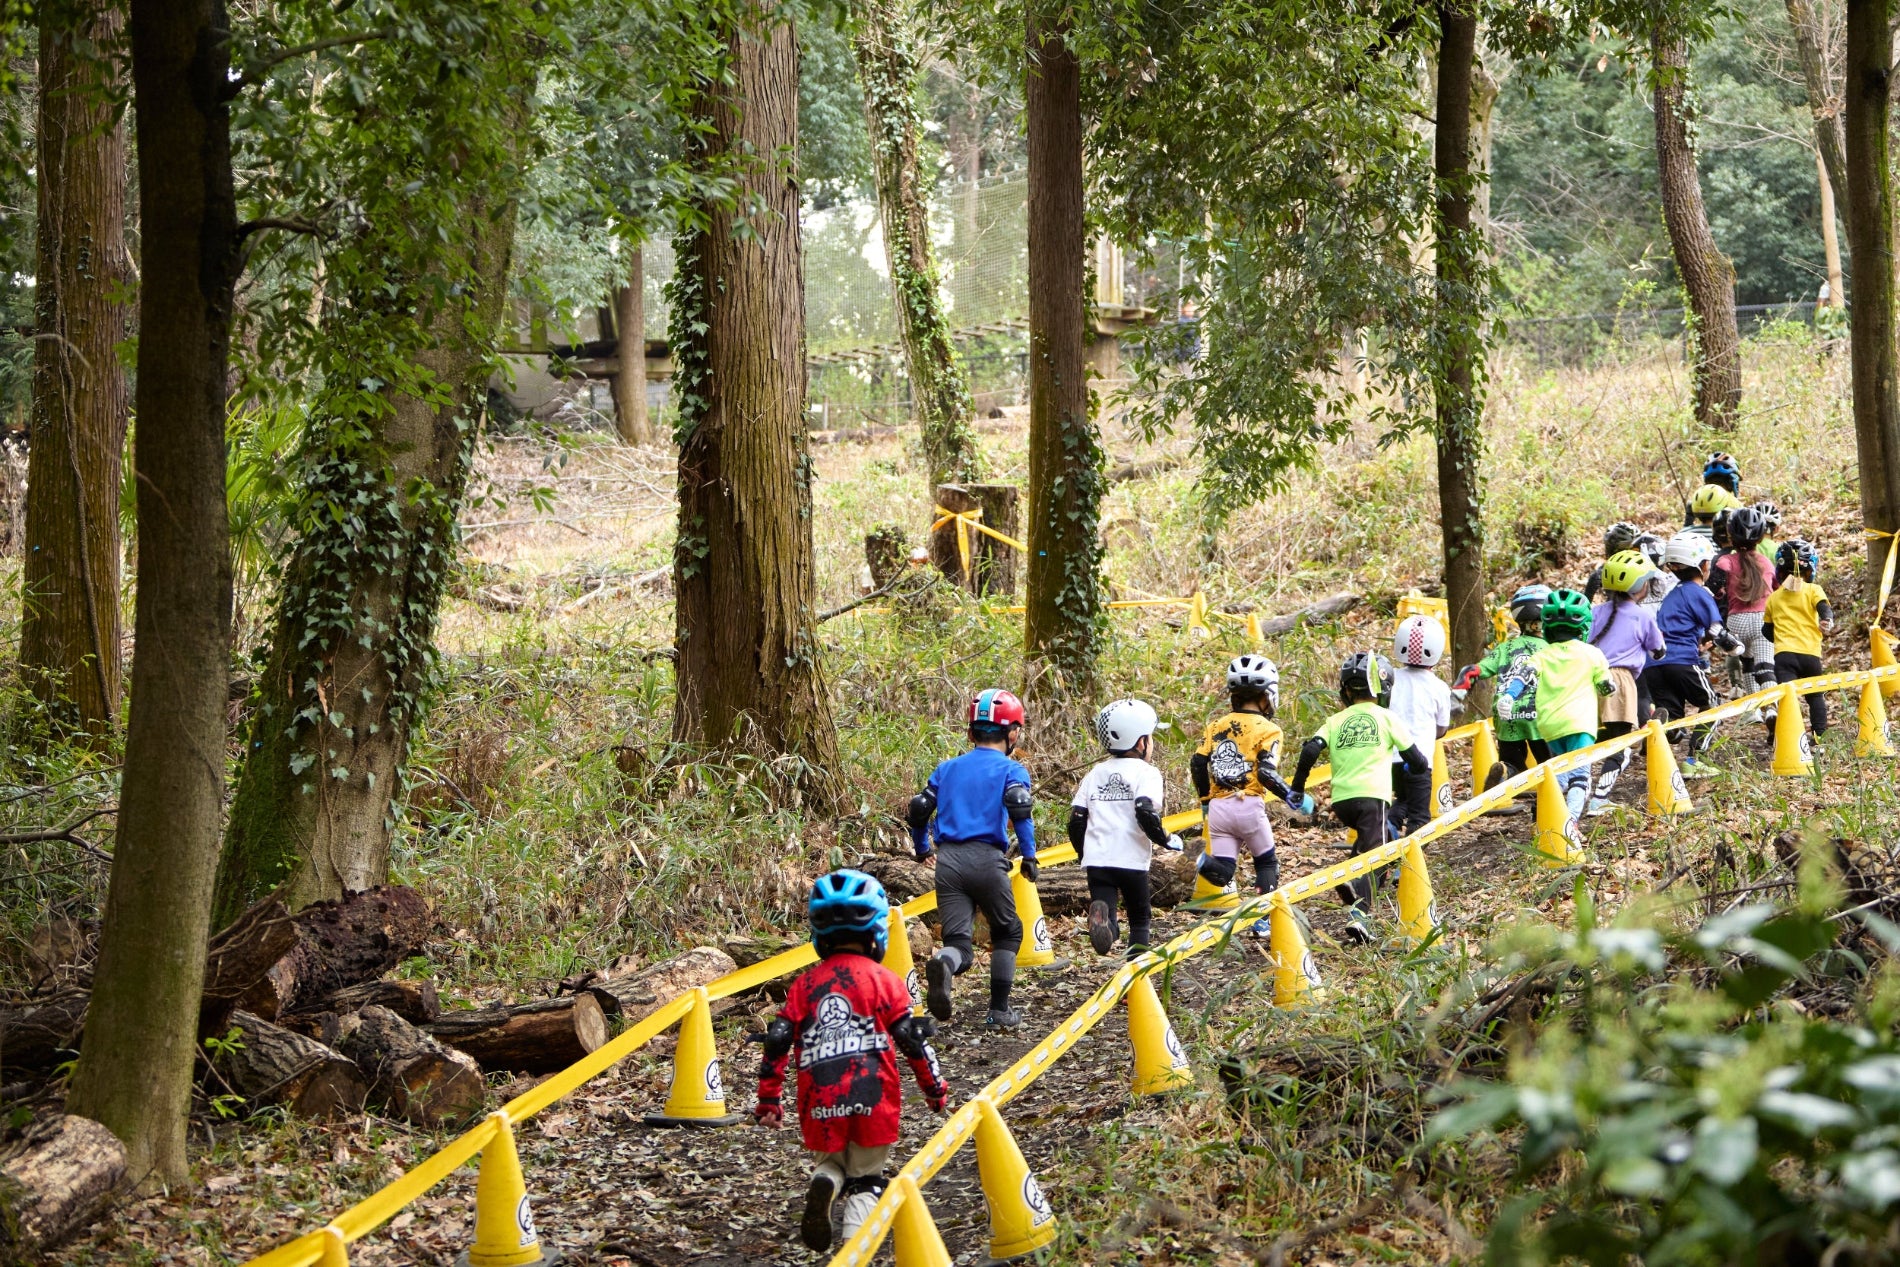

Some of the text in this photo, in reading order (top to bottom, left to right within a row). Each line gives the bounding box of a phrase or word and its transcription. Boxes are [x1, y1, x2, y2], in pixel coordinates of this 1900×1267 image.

[820, 1025, 858, 1046] Team
[800, 1032, 889, 1070] STRIDER
[811, 1103, 873, 1119] #StrideOn
